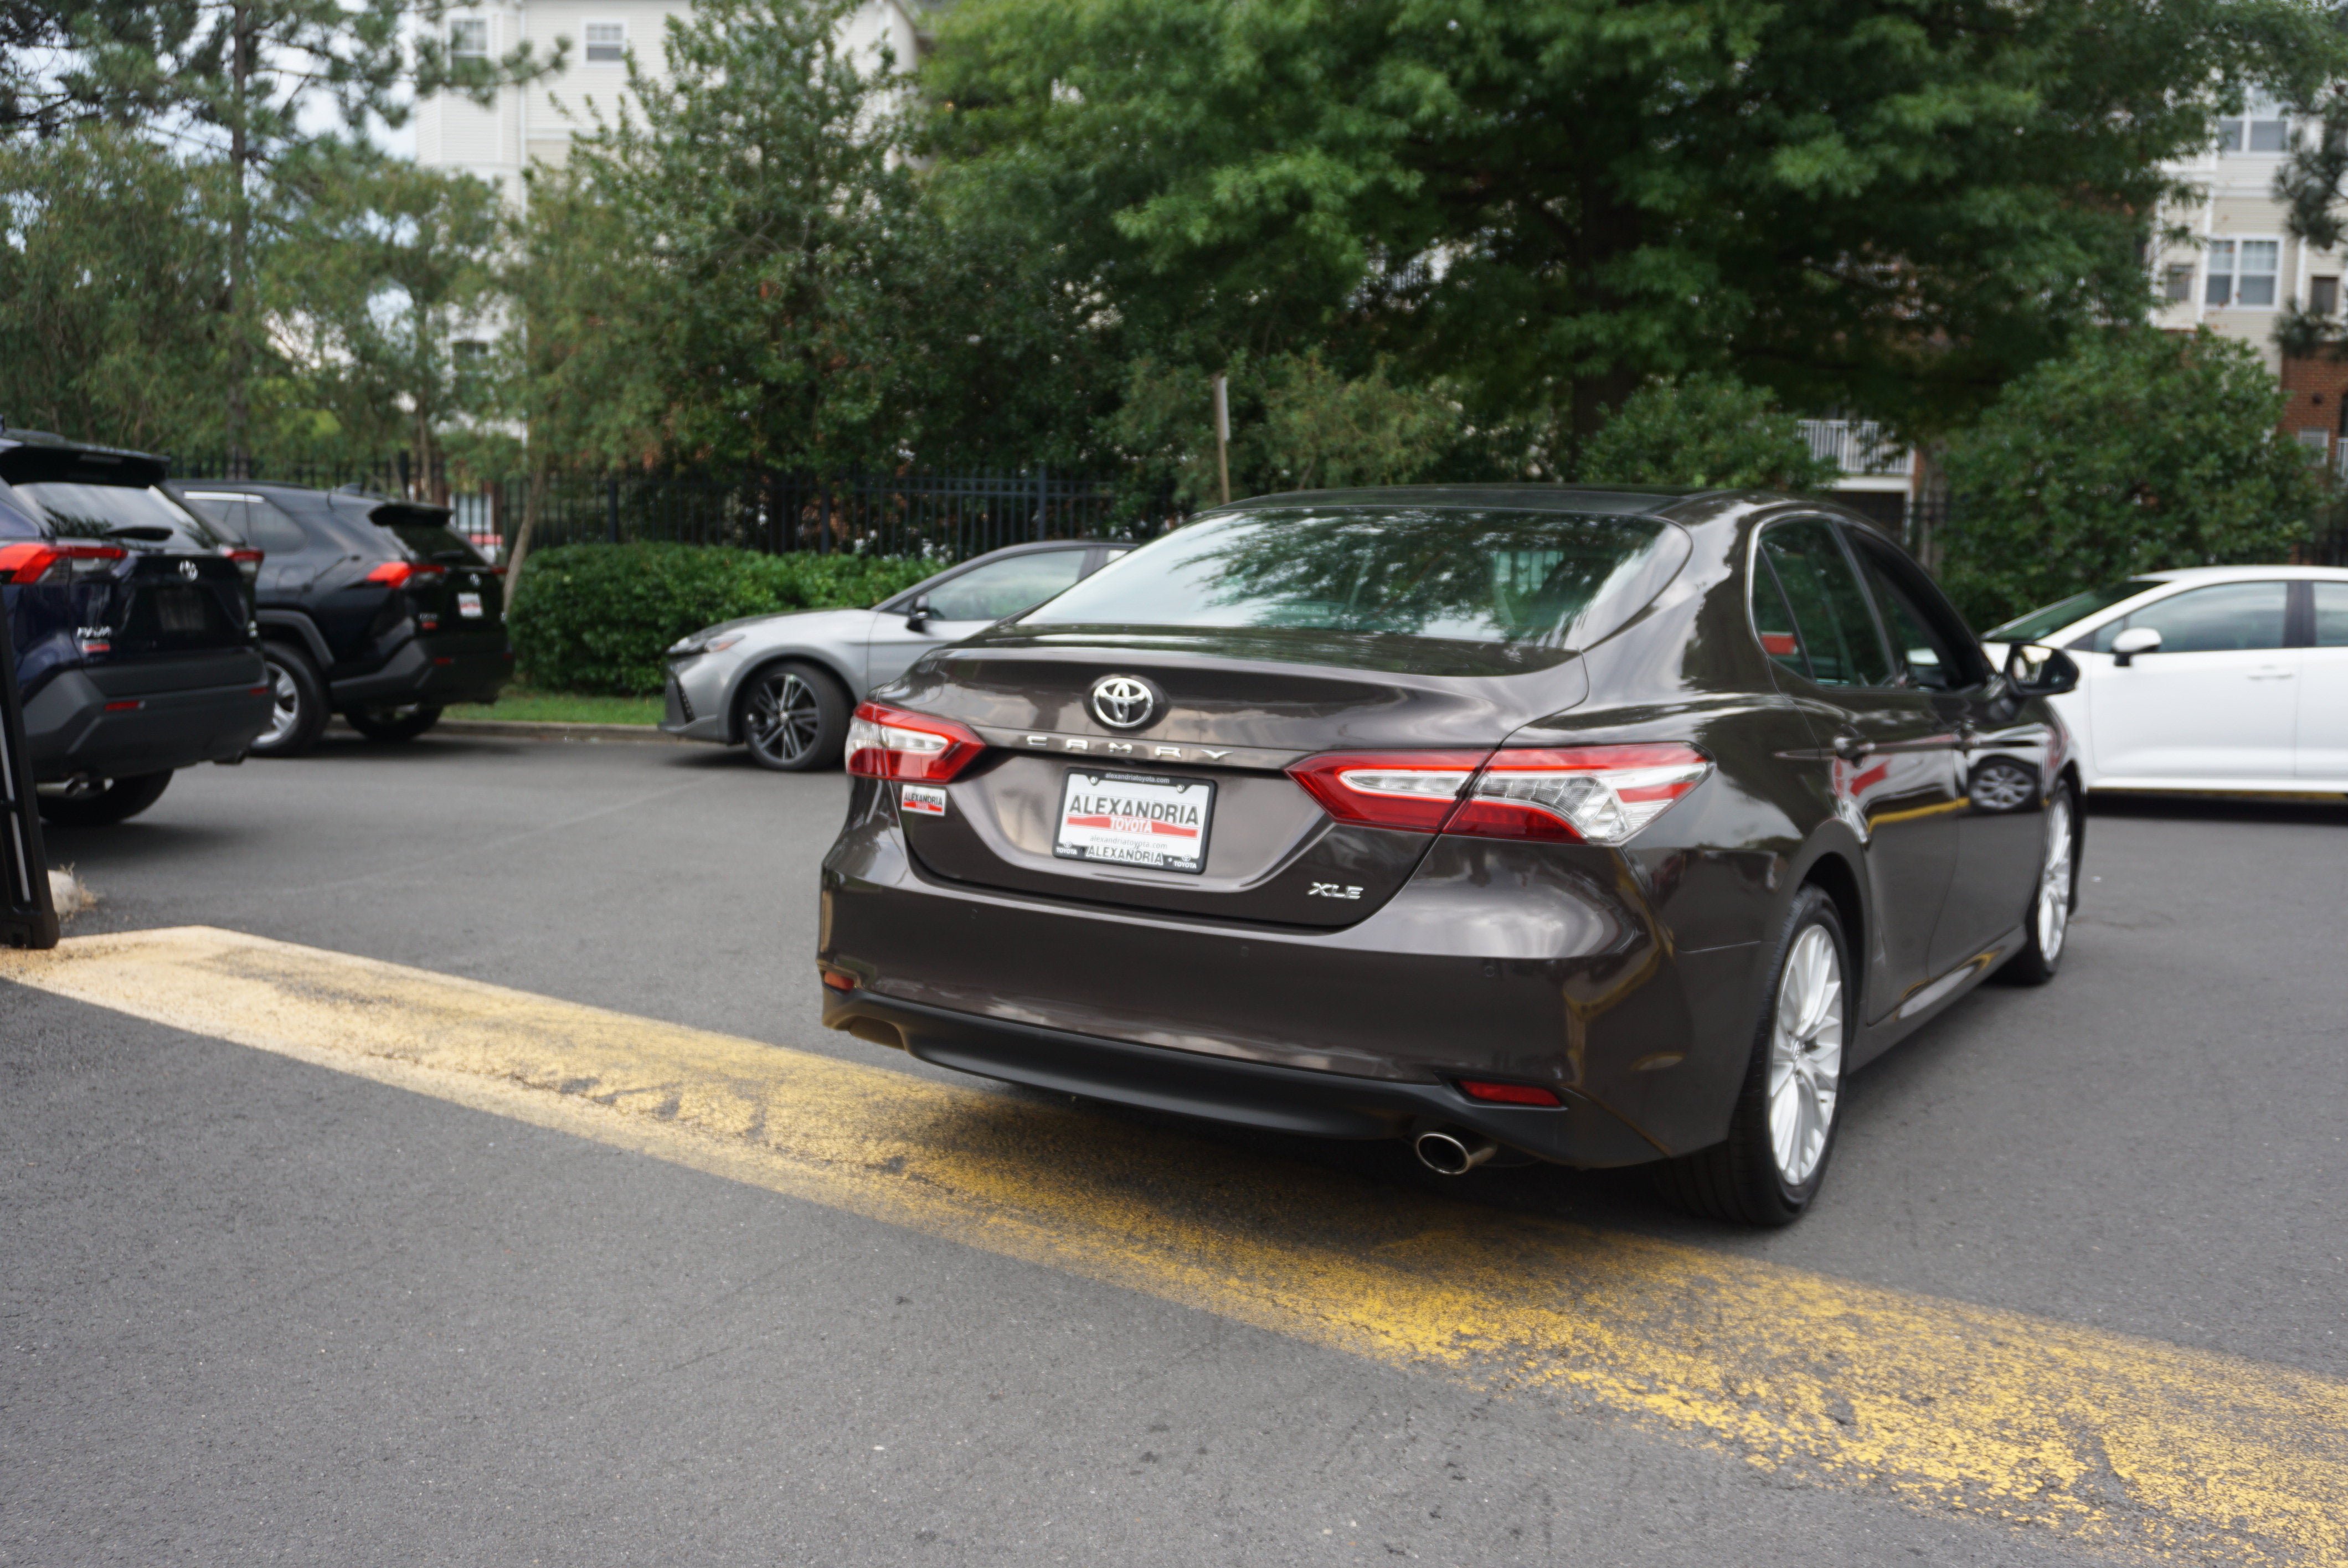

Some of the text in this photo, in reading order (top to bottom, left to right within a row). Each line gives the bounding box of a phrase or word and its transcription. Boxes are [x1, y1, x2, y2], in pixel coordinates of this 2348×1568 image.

[1027, 736, 1234, 761] CAMRY
[1105, 772, 1170, 784] alexandriatoyota.com
[904, 792, 943, 806] ALEXANDRIA
[1069, 795, 1198, 825] ALEXANDRIA
[1110, 818, 1153, 833] TOYOTA
[1089, 834, 1168, 850] alexandriatoyota.com
[1085, 845, 1163, 865] ALEXANDRIA
[1307, 881, 1363, 899] XLE
